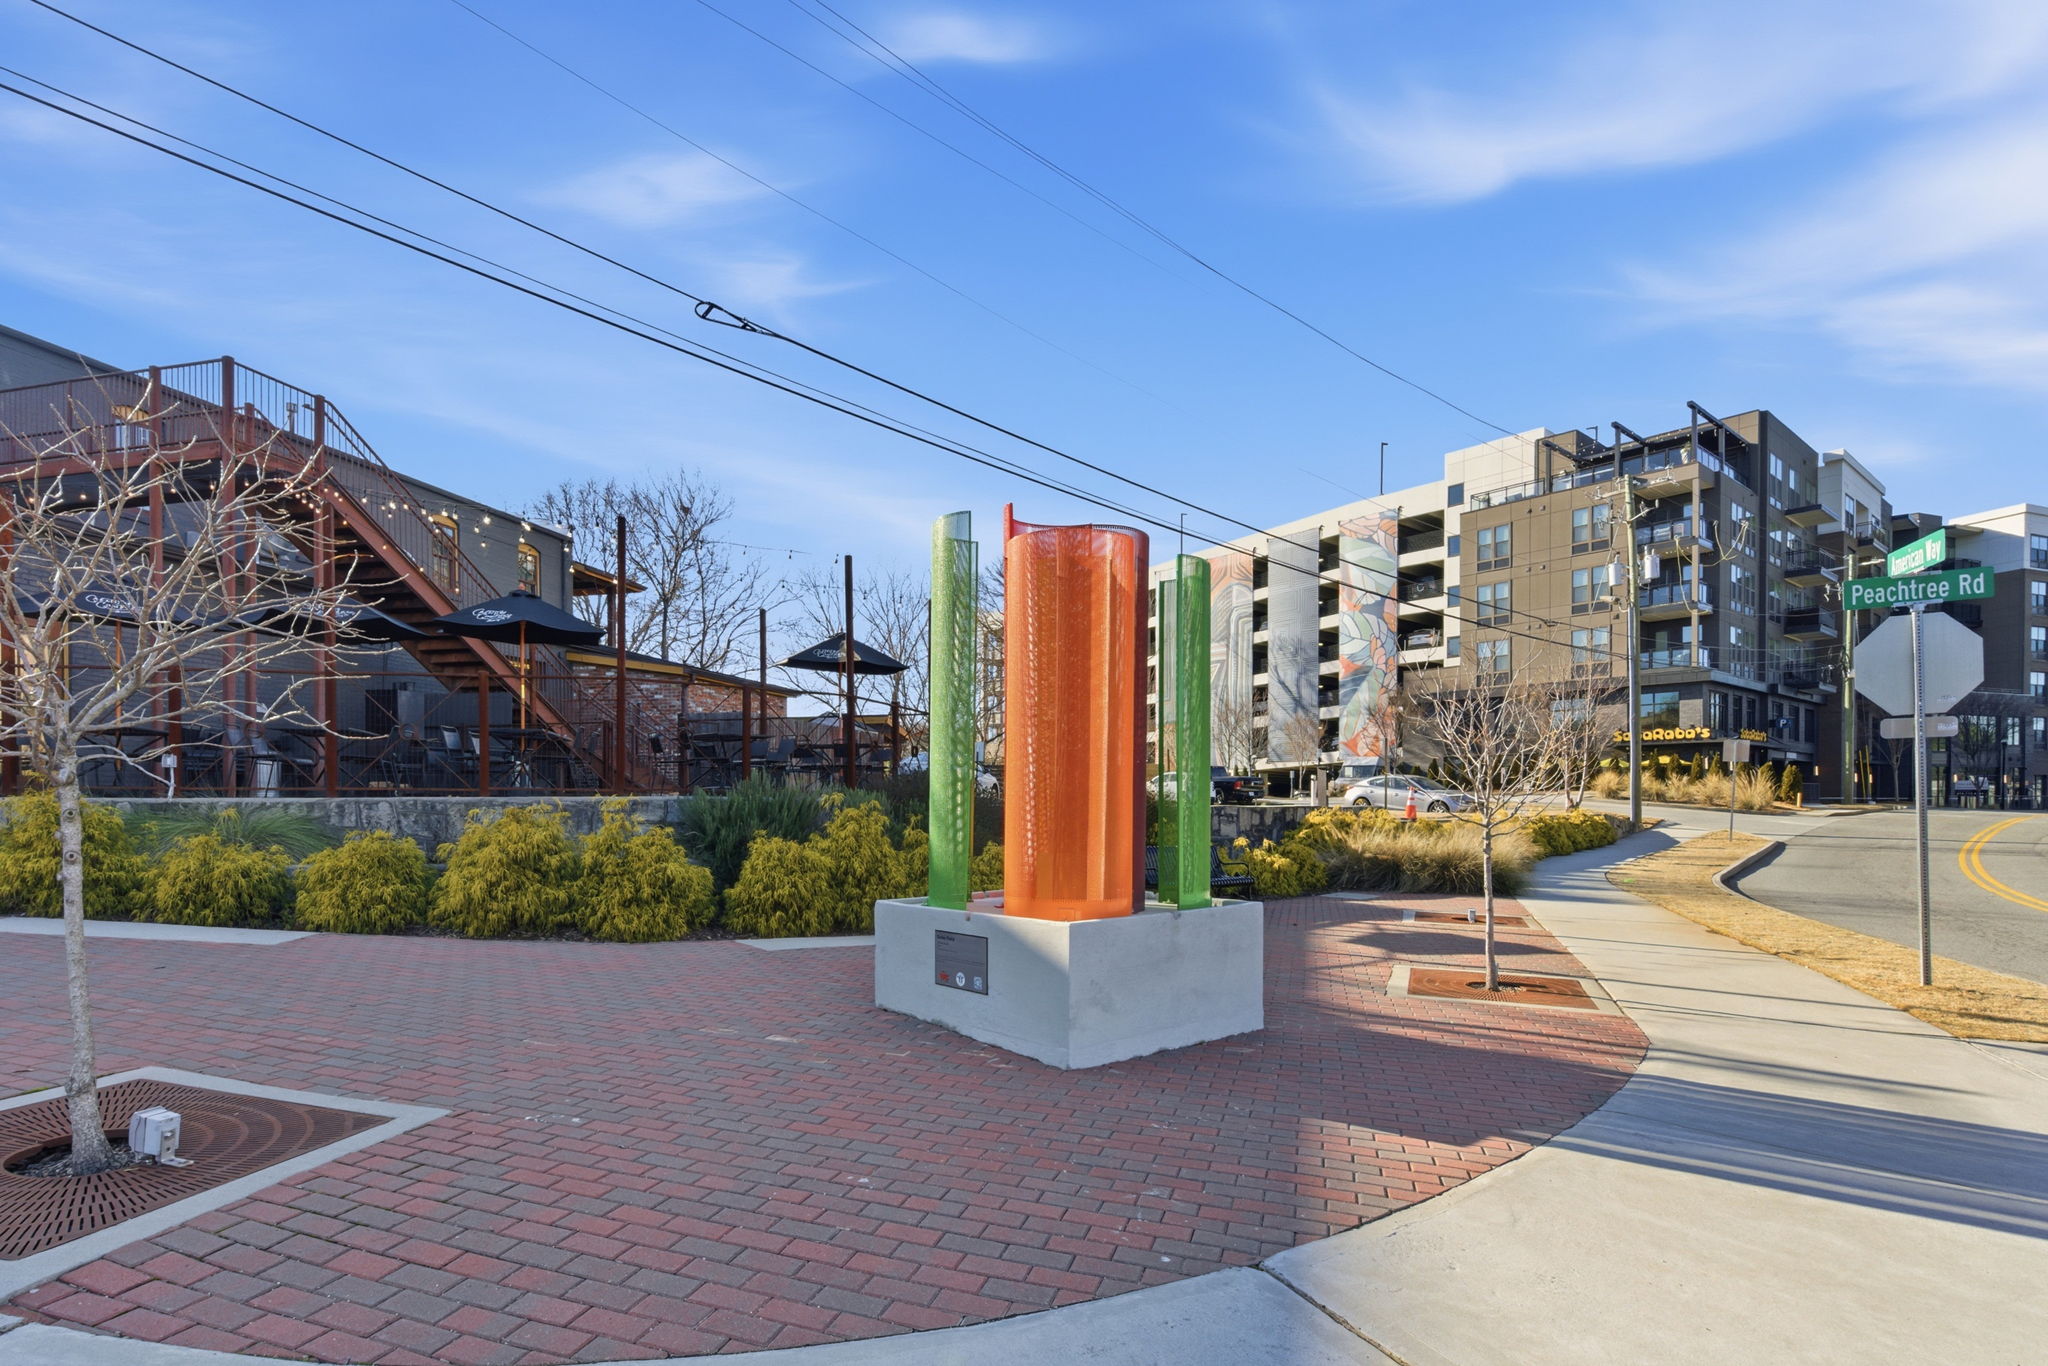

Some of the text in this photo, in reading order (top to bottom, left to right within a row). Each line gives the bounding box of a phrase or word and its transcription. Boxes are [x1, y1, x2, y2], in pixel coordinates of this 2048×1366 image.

[1891, 539, 1942, 576] American Way
[1852, 573, 1985, 605] Peachtree Rd
[1613, 726, 1711, 742] SaaRaba's
[1780, 719, 1787, 727] P
